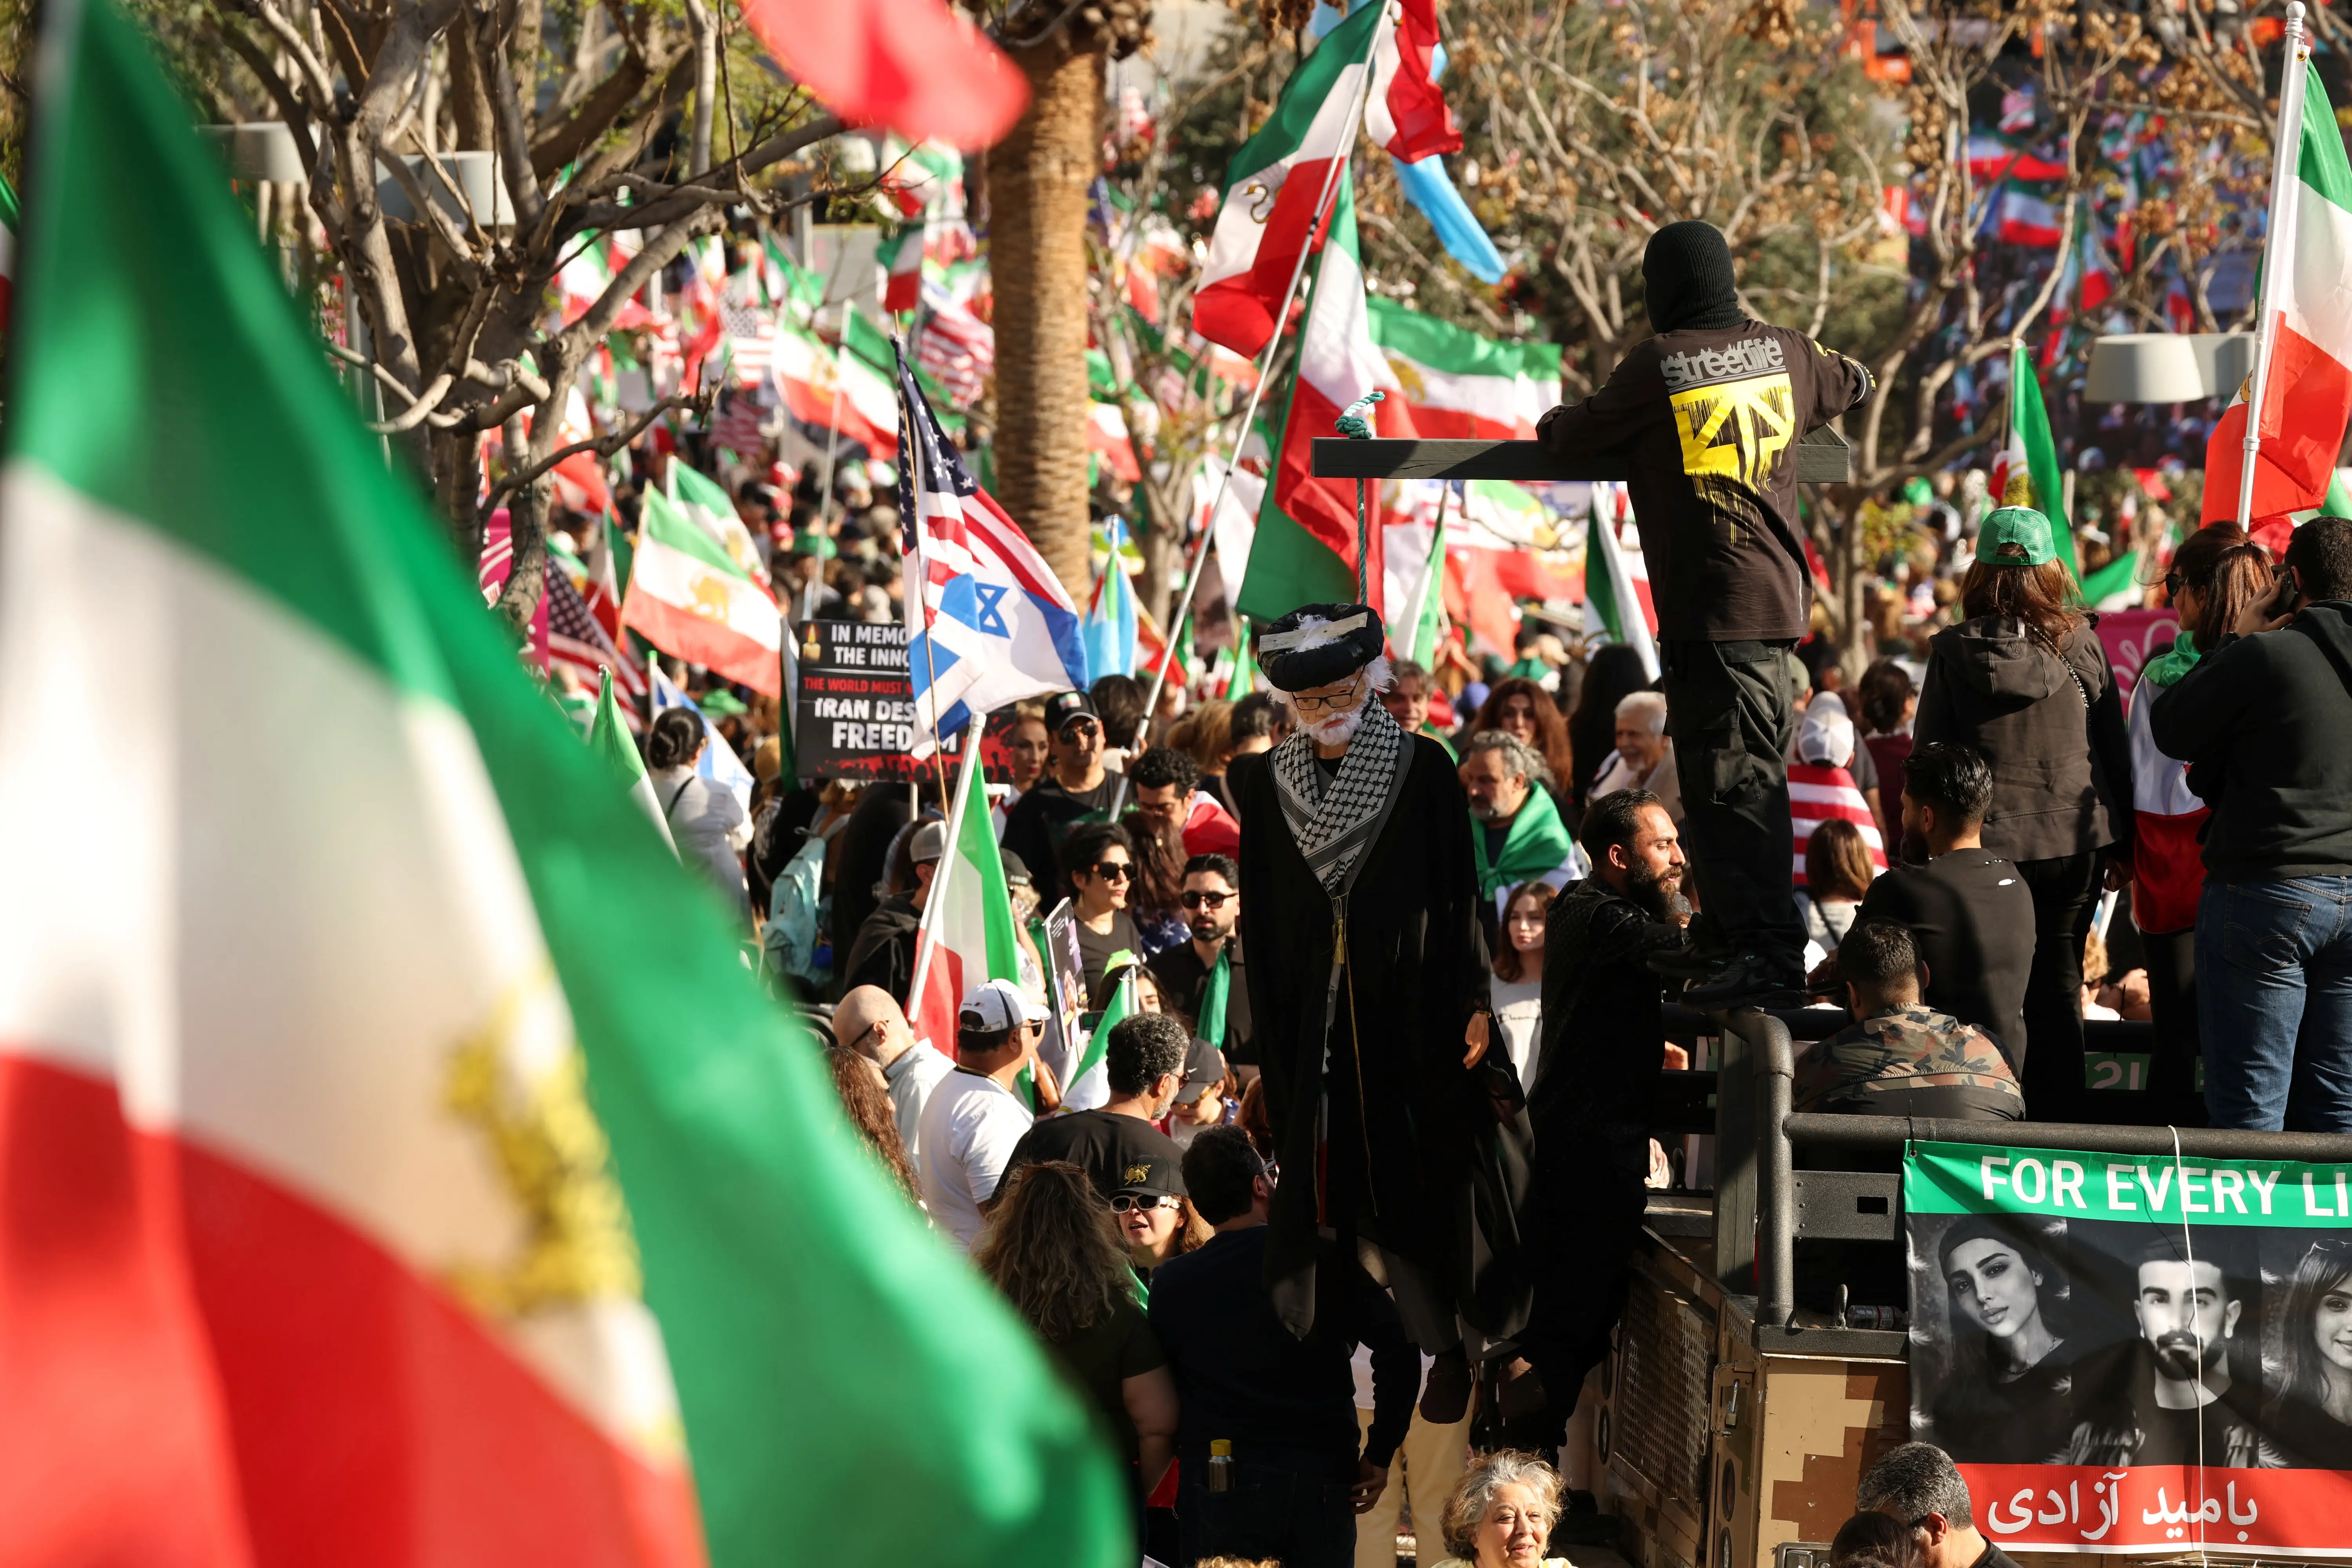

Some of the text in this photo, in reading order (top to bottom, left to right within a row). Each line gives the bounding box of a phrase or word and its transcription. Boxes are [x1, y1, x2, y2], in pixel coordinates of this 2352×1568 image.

[1659, 336, 1784, 387] streetlife
[831, 624, 851, 643] IN
[833, 646, 866, 665] THE
[804, 677, 825, 691] THE
[828, 678, 869, 693] WORLD
[871, 681, 903, 694] MUST
[815, 697, 915, 722] IRAN DES
[832, 721, 956, 752] FREEDM
[1981, 1156, 2349, 1217] FOR EVERY LI
[1988, 1471, 2127, 1540] آزادی
